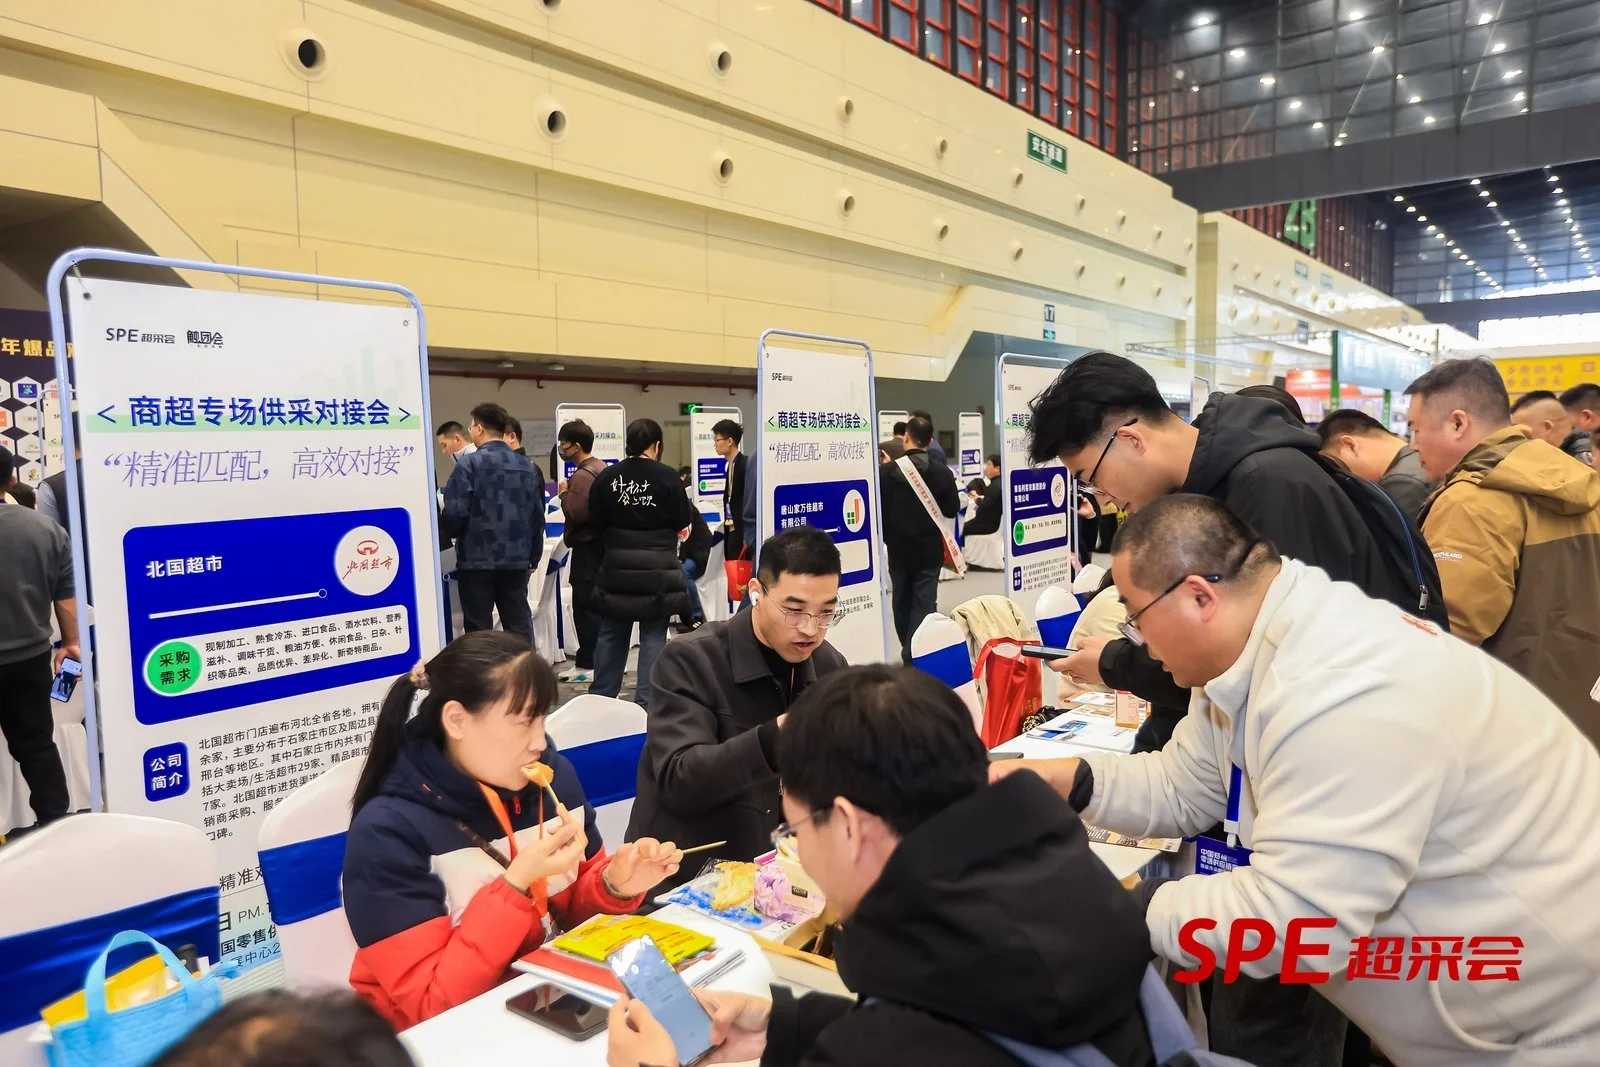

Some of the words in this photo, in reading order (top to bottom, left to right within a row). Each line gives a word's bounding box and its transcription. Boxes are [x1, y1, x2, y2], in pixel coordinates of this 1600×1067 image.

[106, 328, 139, 342] SPE
[771, 372, 782, 381] SPE
[130, 396, 390, 427] 商超专场供采对接会
[777, 411, 861, 429] 商超专场供采对接会
[780, 516, 807, 529] 有限公司
[146, 555, 223, 579] 北国超市
[205, 613, 402, 652] 现制加工、熟食冷冻、进口食品、酒水饮料、营养
[206, 626, 402, 667] 滋补、调味干货、粮油方便、休闲食品、日杂、针
[159, 651, 190, 667] 采购
[207, 645, 383, 682] 织等品类，品质优异、差异化、新奇特商品。
[160, 669, 192, 685] 需求
[200, 715, 379, 766] 余家，主要分布于石家庄市区及周边县
[151, 753, 182, 773] 公司
[201, 730, 373, 781] 邢台等地区。其中石家庄市内共有门
[152, 772, 183, 791] 简介
[202, 770, 326, 811] 7家。北国超市进货渠
[203, 796, 288, 827] 销商采购、服
